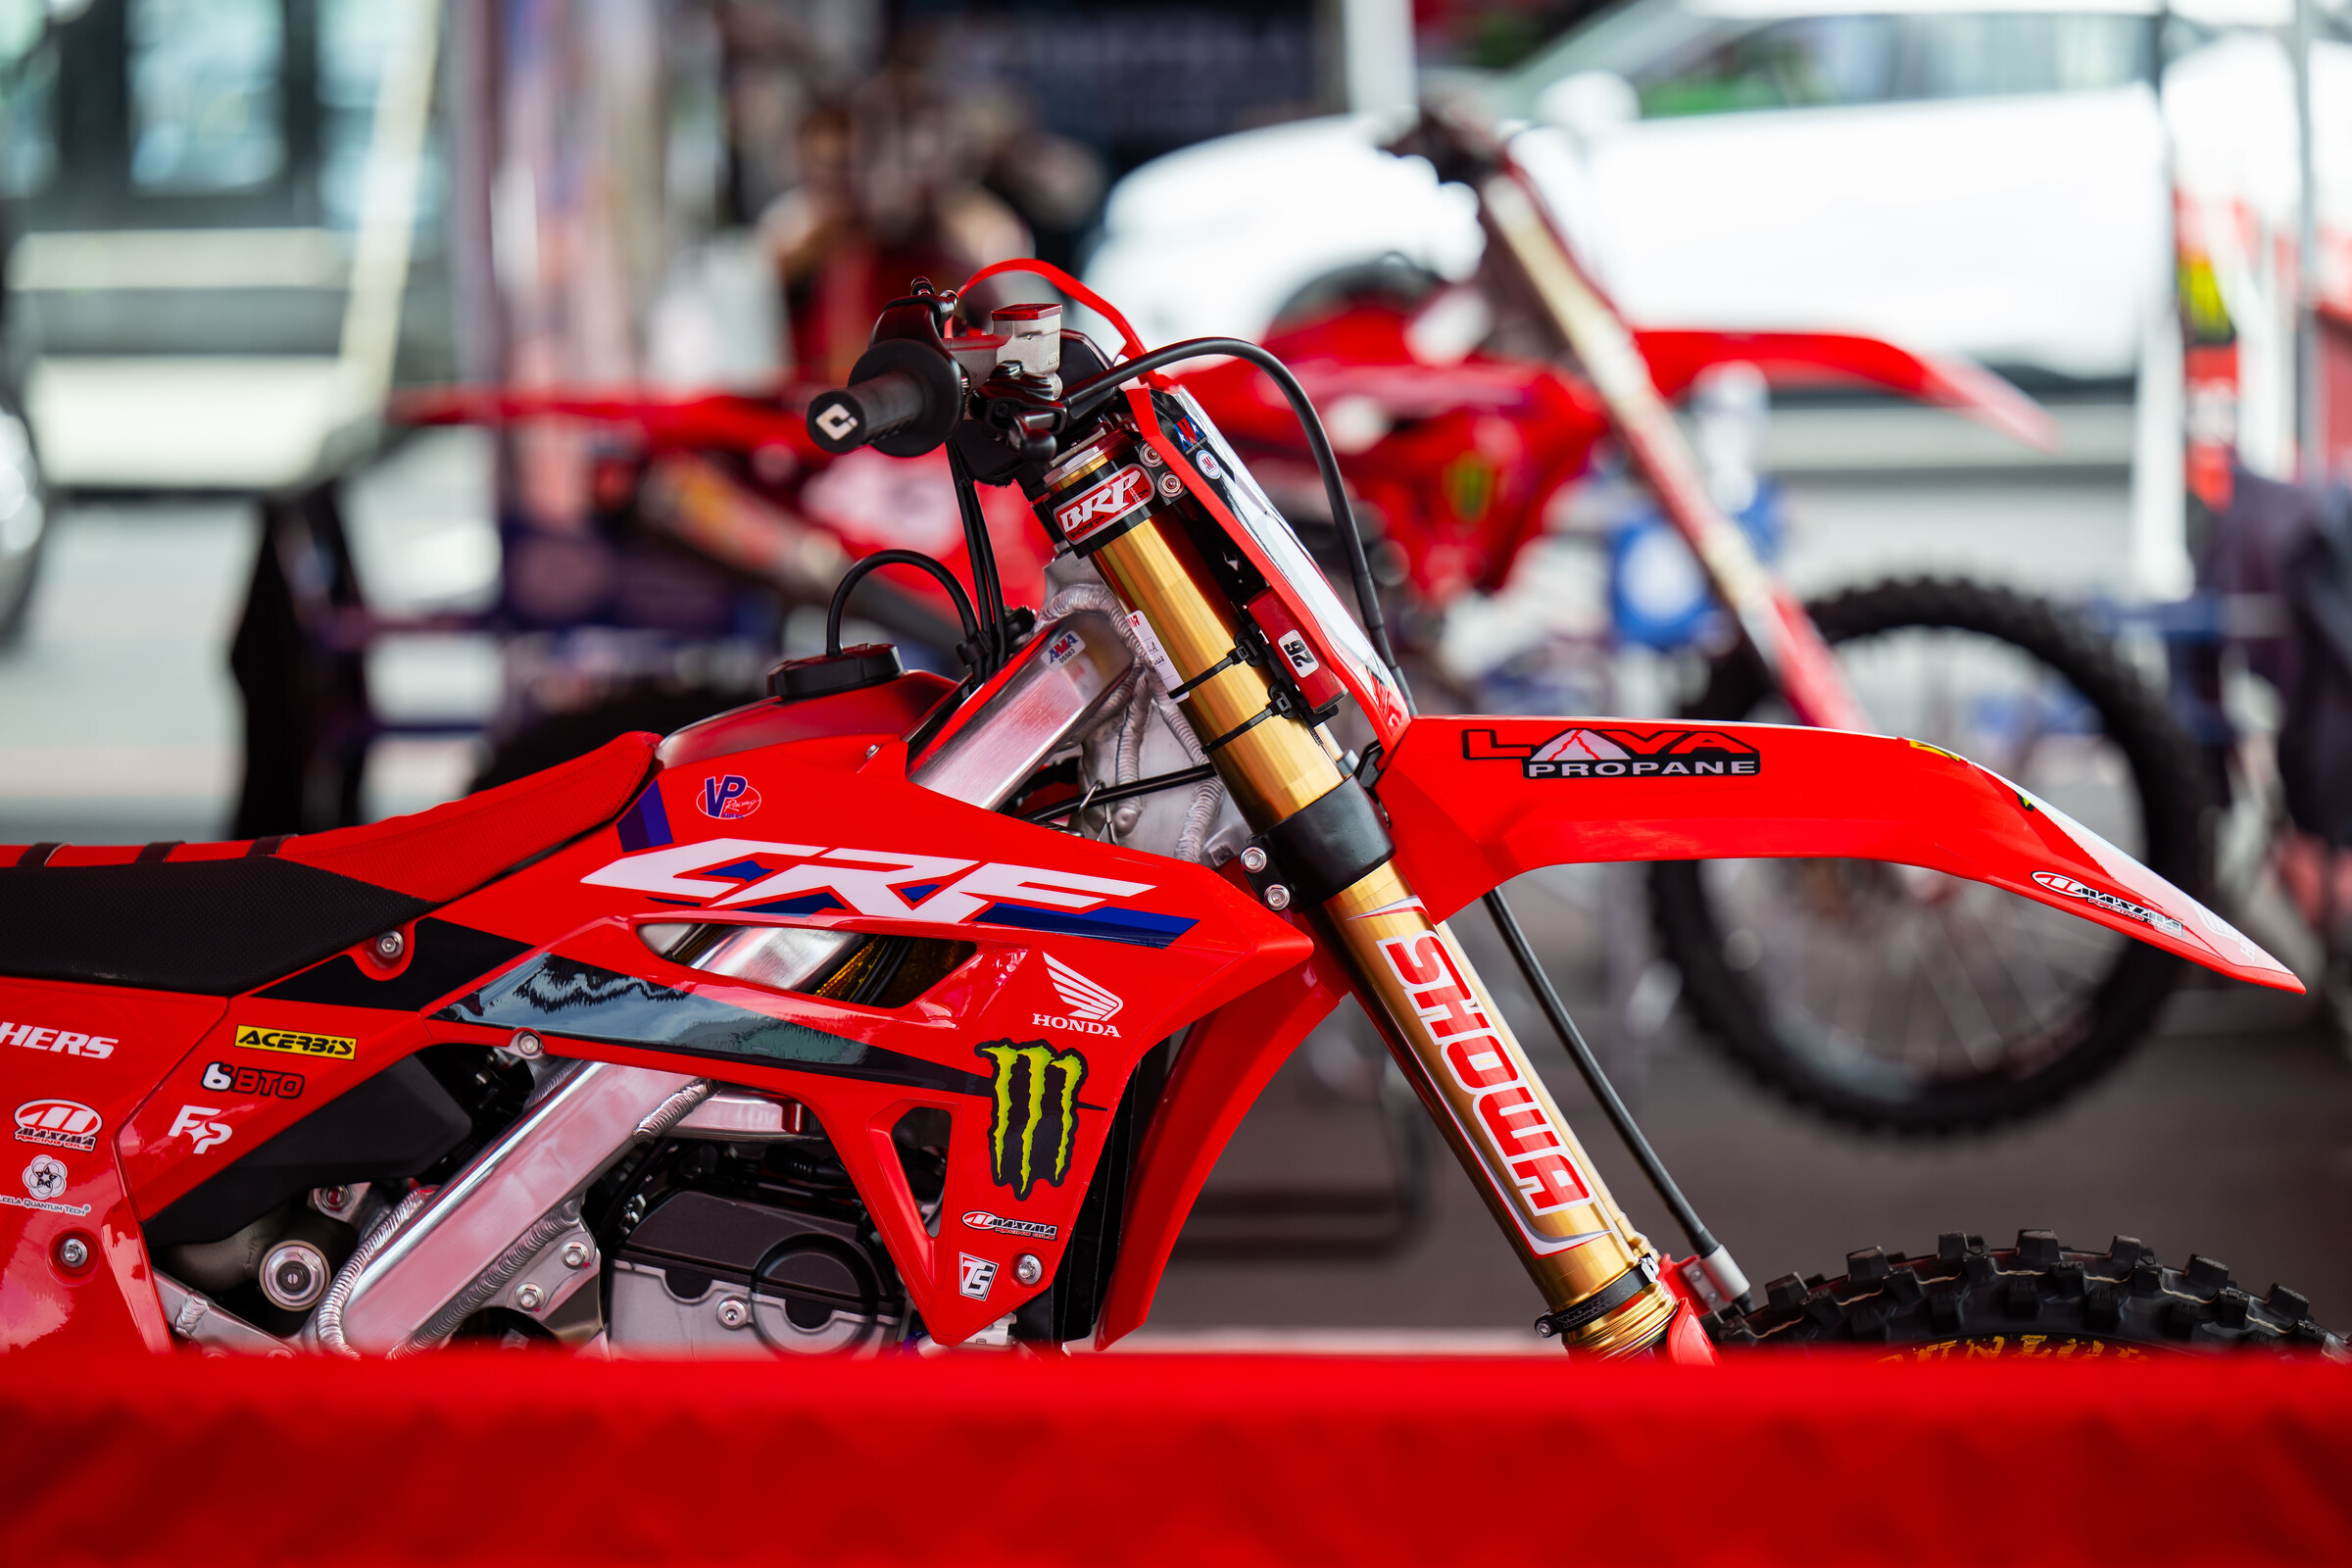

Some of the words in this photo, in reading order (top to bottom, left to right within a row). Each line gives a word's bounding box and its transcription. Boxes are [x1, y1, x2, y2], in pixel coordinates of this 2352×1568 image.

[1059, 470, 1142, 533] BRP
[1049, 633, 1078, 664] AMA
[1462, 728, 1761, 760] LAVA
[1528, 760, 1756, 777] PROPANE
[705, 774, 748, 818] VP
[580, 837, 1157, 923] CRF
[0, 1021, 119, 1059] HERS
[1032, 1012, 1122, 1038] HONDA
[238, 1030, 353, 1055] ACERBIS
[1376, 930, 1595, 1216] SHOWA
[16, 1127, 94, 1146] MAXIMA
[988, 1218, 1056, 1234] MAXIMA
